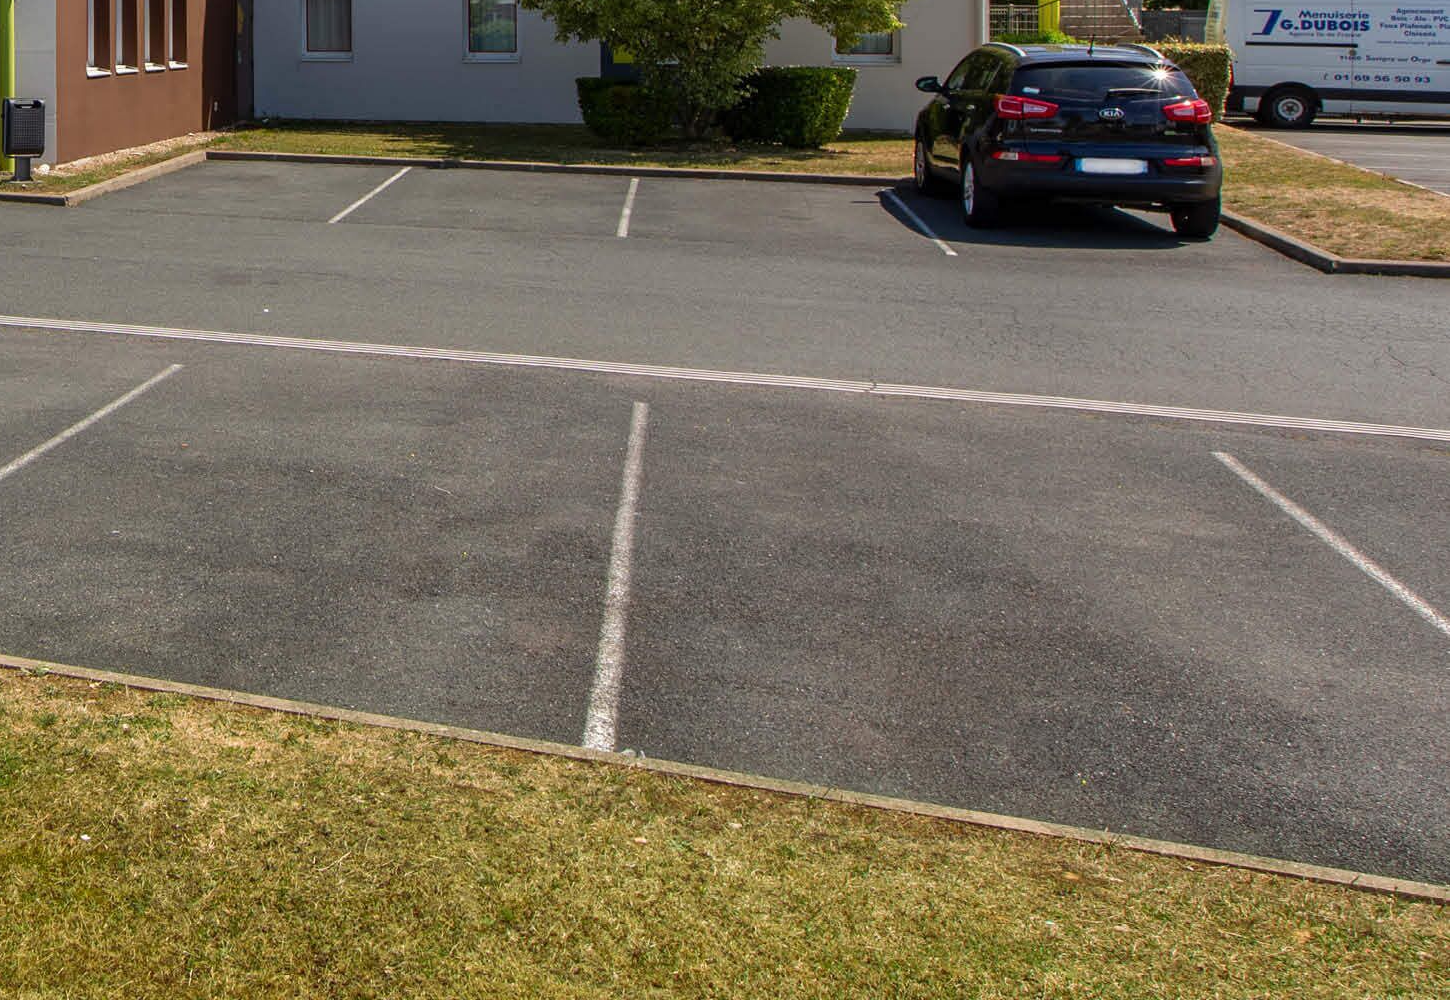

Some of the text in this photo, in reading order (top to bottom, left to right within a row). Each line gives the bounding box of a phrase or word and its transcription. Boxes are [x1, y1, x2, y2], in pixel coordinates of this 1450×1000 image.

[1298, 10, 1370, 20] Menuiserie
[1280, 19, 1370, 32] G.DUBOIS
[1334, 73, 1349, 81] 01
